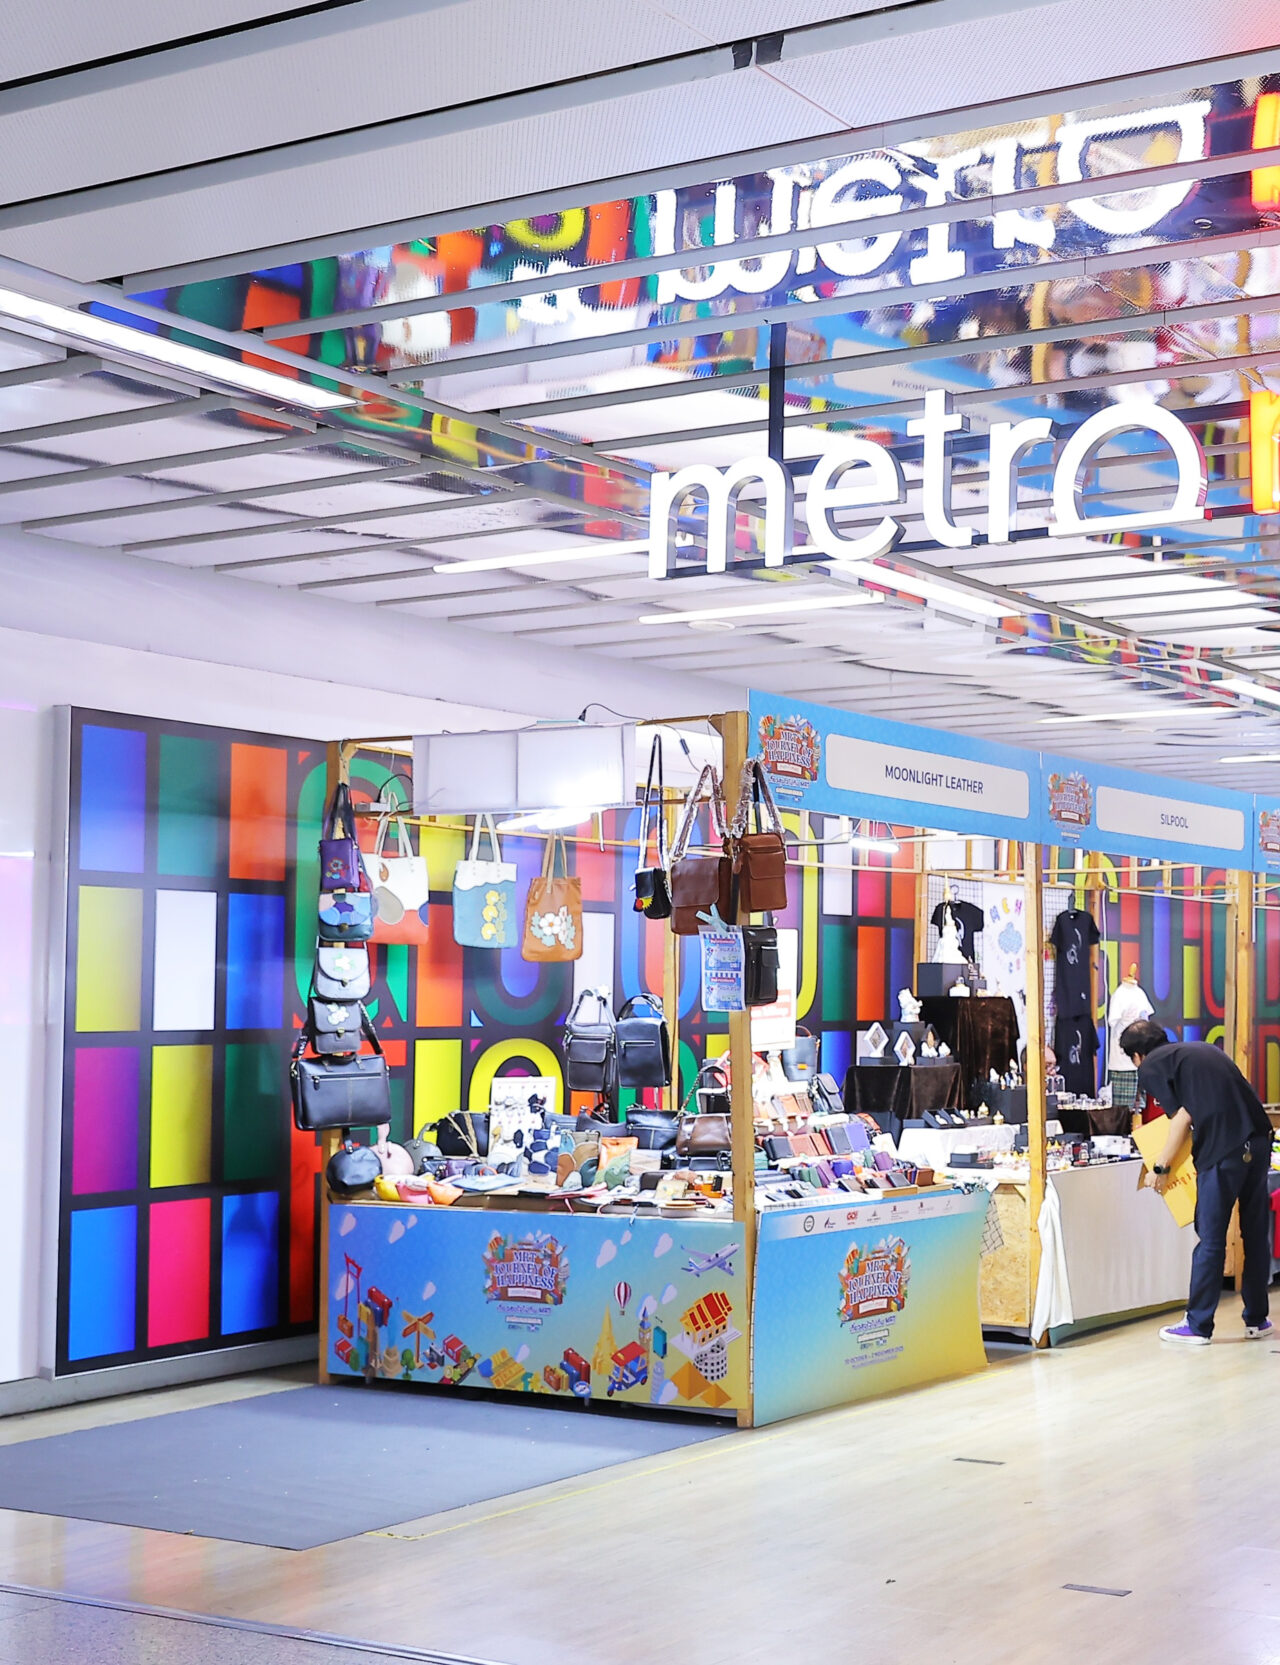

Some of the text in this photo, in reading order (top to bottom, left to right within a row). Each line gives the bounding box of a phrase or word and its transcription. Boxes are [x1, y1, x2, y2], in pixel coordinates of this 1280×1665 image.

[648, 389, 1210, 580] metro
[781, 731, 799, 741] MRT
[767, 740, 801, 753] JOURNEY
[768, 750, 811, 768] HAPPINESS
[885, 765, 983, 794] MOONLIGHT LEATHER
[1160, 813, 1189, 829] SILPOOL
[514, 1251, 537, 1262] MRT
[494, 1263, 559, 1279] JOURNEY OF
[866, 1259, 885, 1272] MRT
[496, 1274, 555, 1290] HAPPINESS
[847, 1270, 902, 1294] JOURNEY OF
[849, 1283, 898, 1305] HAPPINESS
